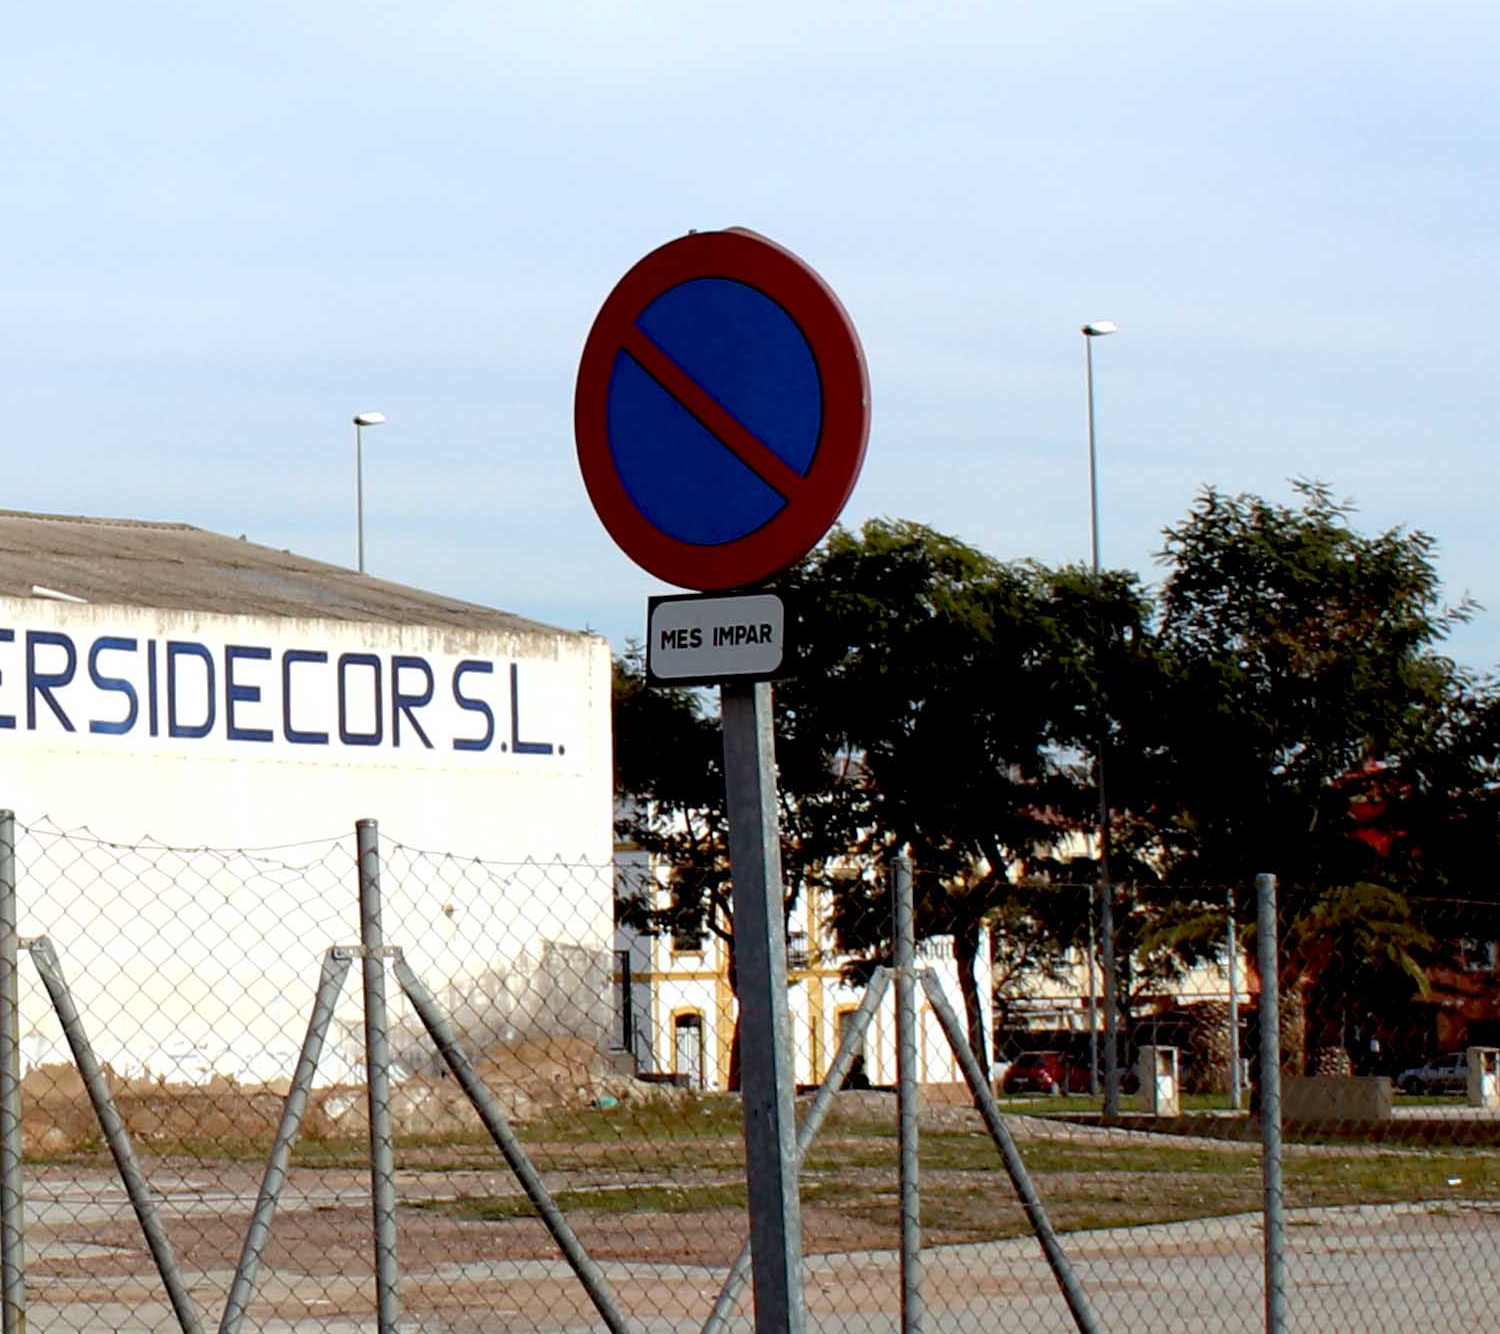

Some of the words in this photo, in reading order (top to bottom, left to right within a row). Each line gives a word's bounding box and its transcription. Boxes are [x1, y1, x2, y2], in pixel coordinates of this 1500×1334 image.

[661, 628, 703, 650] MES
[712, 624, 773, 647] IMPAR
[452, 659, 566, 756] S.L.
